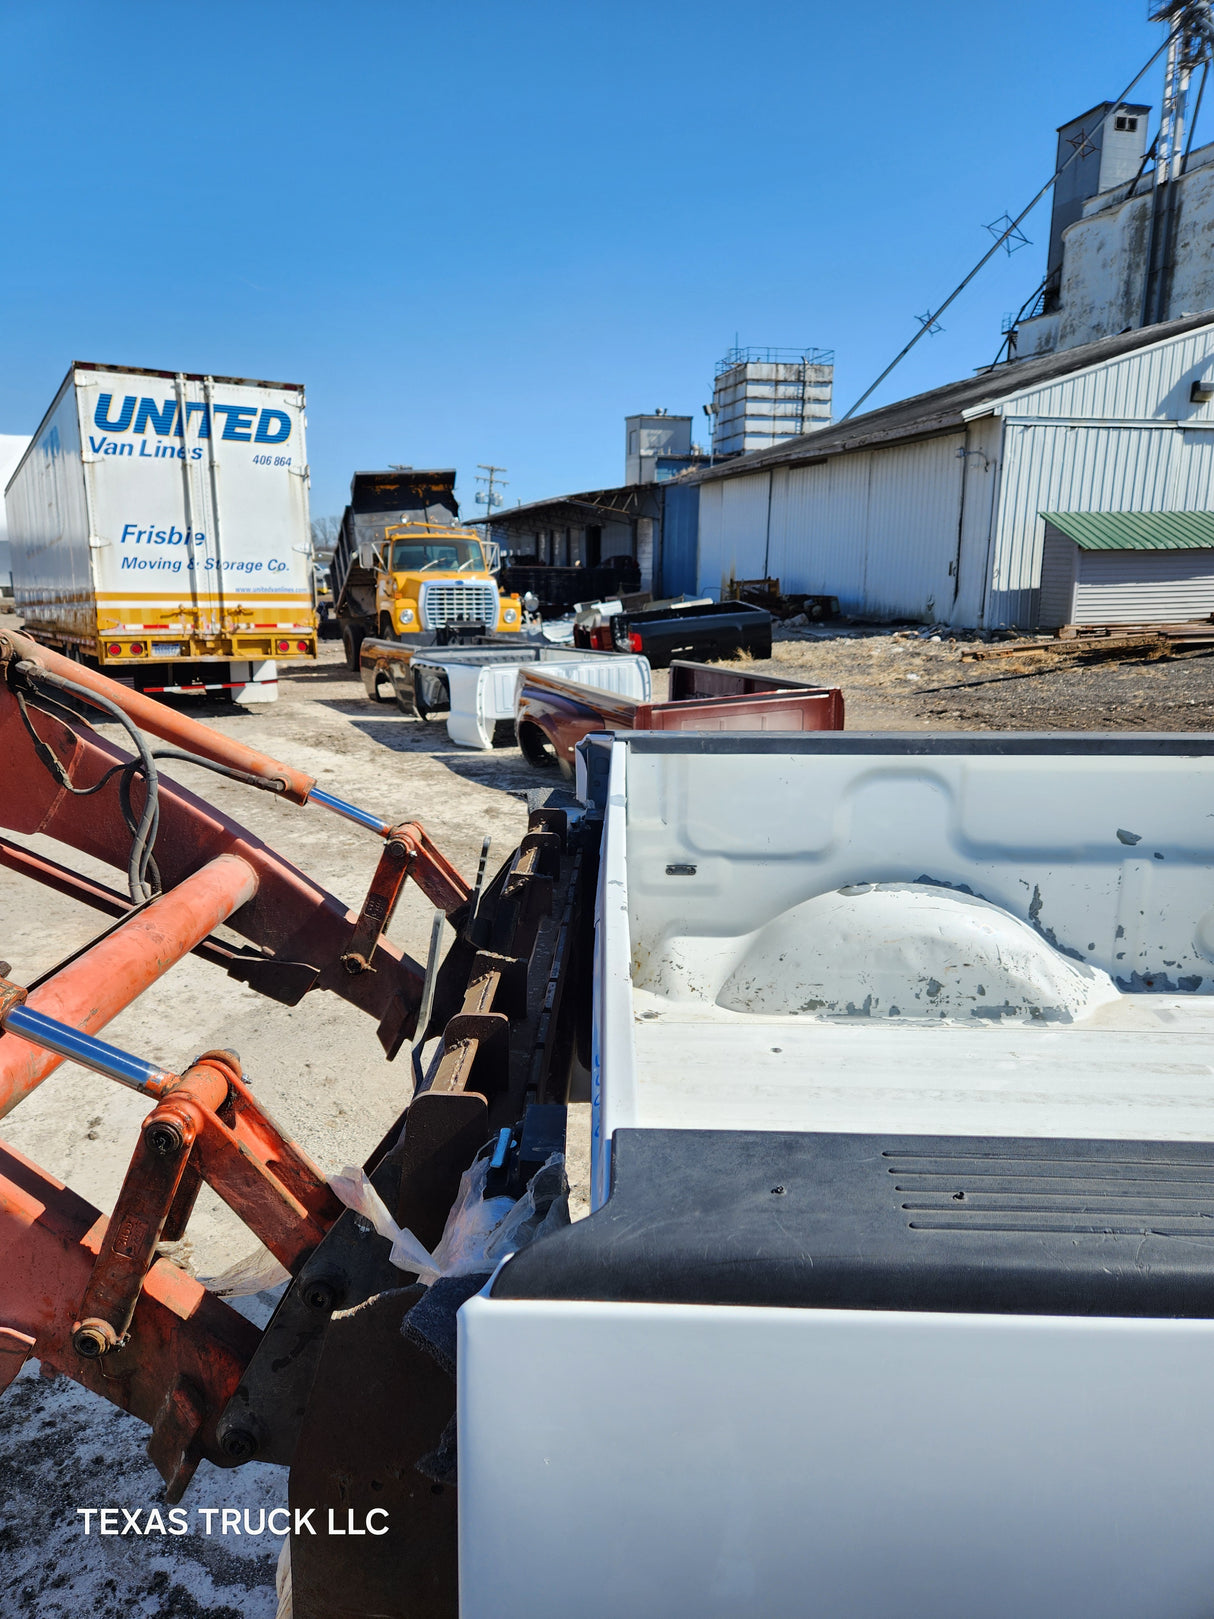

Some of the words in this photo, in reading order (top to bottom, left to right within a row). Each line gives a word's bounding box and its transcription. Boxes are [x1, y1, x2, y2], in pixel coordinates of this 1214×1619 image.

[94, 393, 292, 445] UNITED
[89, 436, 134, 456] Van
[139, 437, 203, 460] Lines
[252, 455, 272, 466] 406
[273, 456, 292, 467] 864
[120, 524, 206, 546] Frisbie
[121, 557, 182, 573] Moving
[204, 557, 263, 574] Storage
[267, 559, 290, 572] Co.
